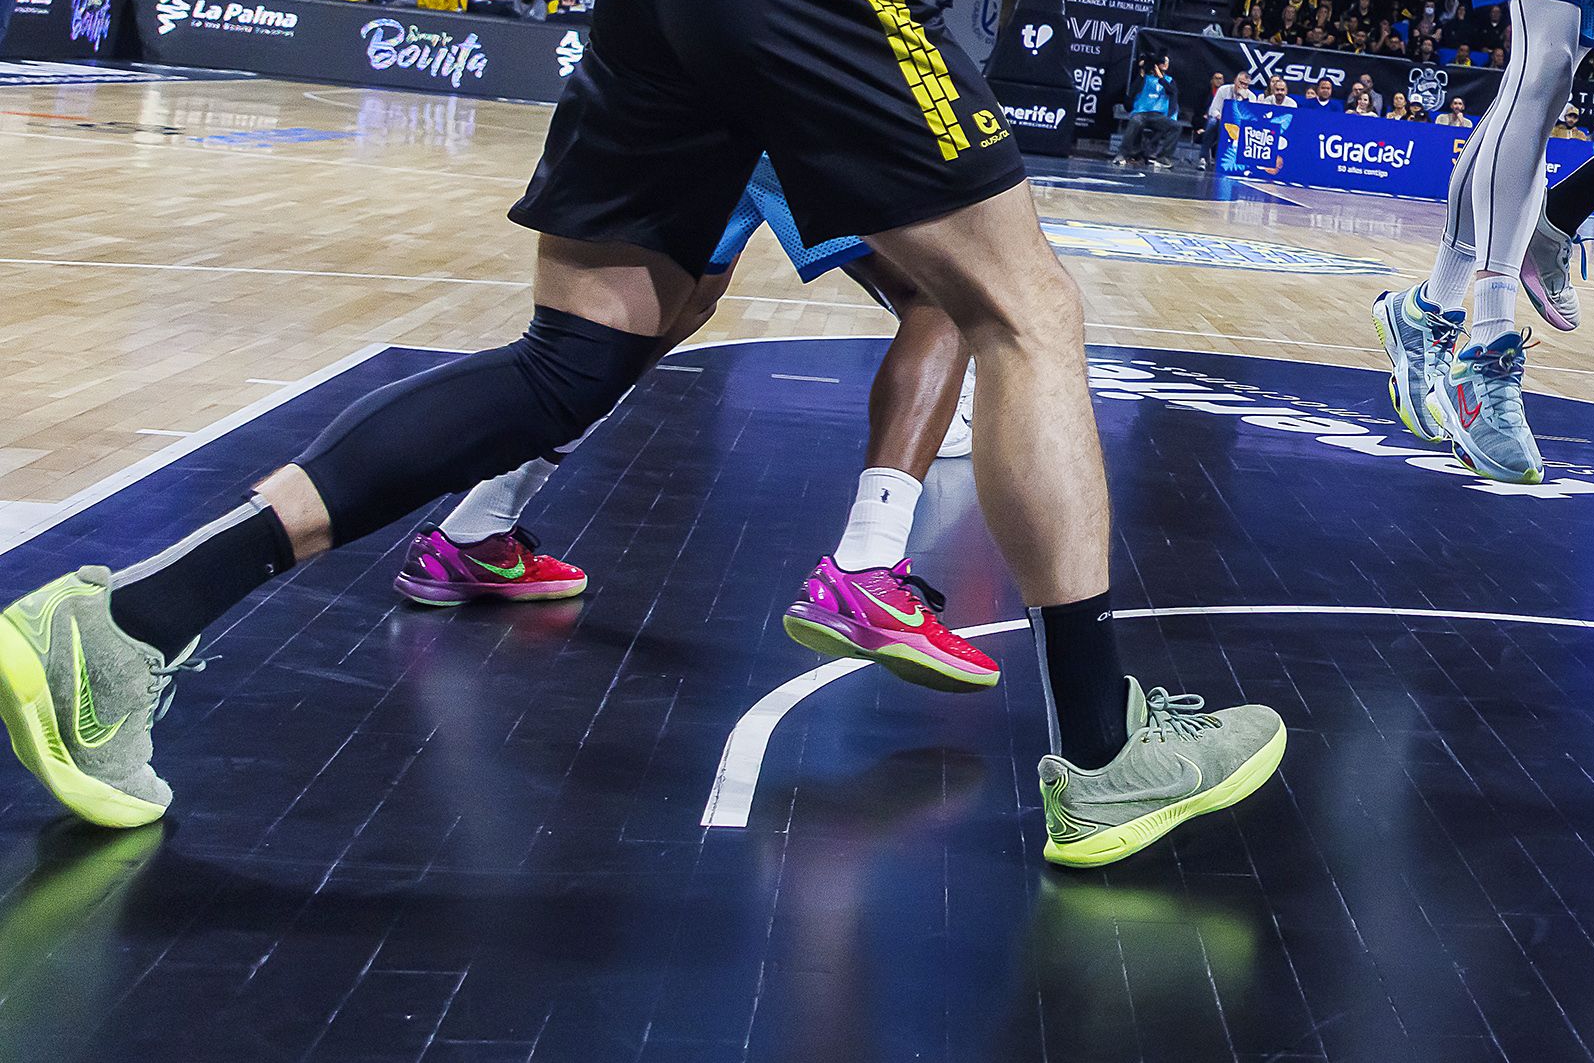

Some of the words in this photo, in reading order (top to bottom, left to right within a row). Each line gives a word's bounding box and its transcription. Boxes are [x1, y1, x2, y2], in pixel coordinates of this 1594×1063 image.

[192, 0, 223, 20] La
[223, 3, 298, 28] Palma
[1239, 42, 1346, 87] X-SUR
[1337, 165, 1347, 174] 50
[1347, 166, 1363, 175] años
[1364, 168, 1389, 178] contigo
